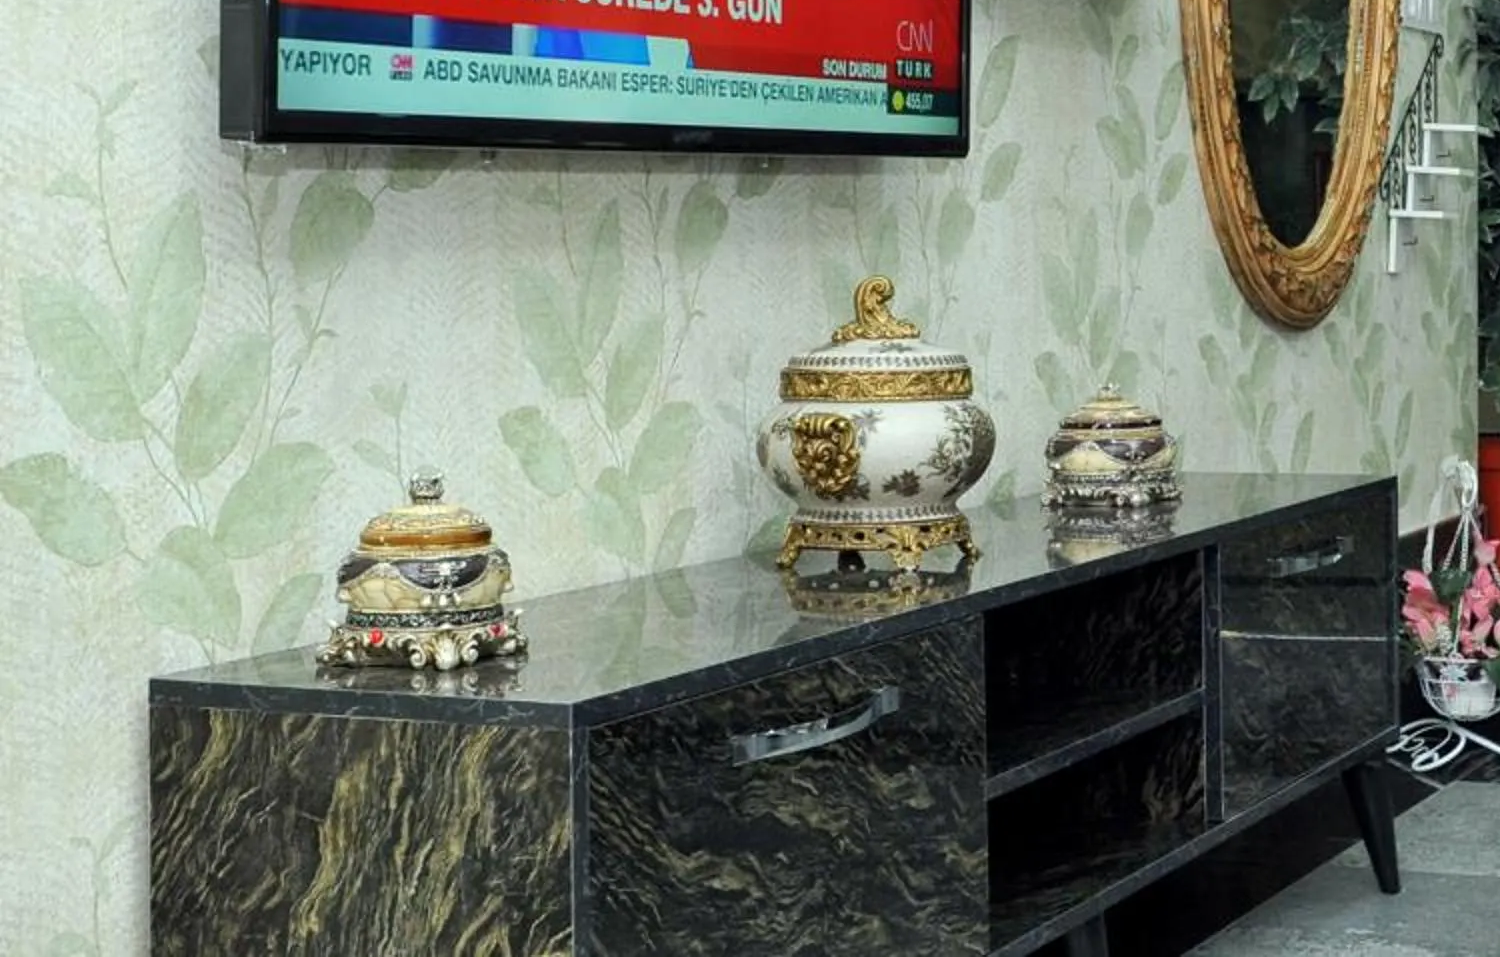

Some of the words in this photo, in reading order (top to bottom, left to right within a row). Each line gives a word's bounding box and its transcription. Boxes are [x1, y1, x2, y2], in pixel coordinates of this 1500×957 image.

[896, 18, 934, 52] CNN
[280, 48, 372, 77] YAPIYOR
[423, 59, 463, 82] ABD
[467, 61, 553, 87] SAVUNMA
[557, 68, 617, 92] BAKANI
[822, 58, 847, 77] SON
